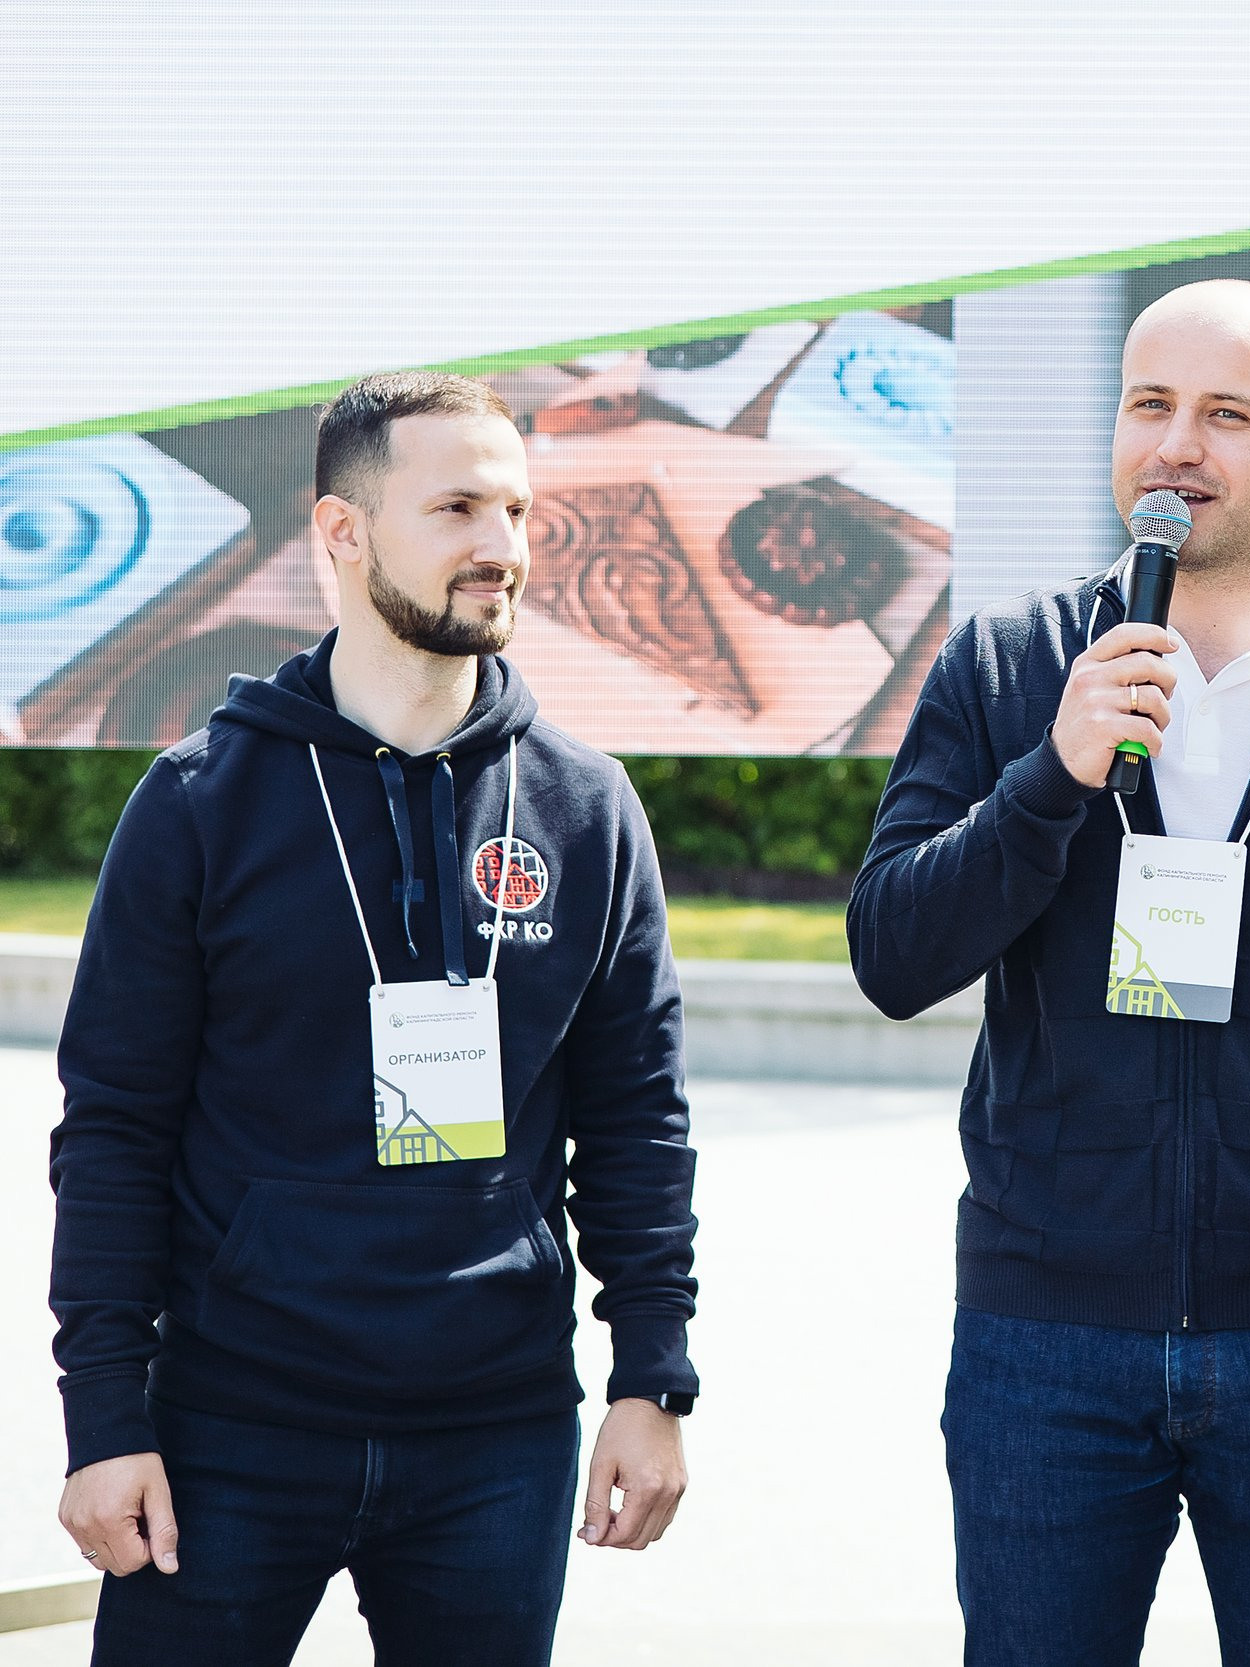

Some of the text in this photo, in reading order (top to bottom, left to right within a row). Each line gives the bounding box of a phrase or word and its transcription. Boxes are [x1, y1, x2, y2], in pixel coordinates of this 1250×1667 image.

[1148, 906, 1206, 925] ГОСТЬ
[524, 921, 554, 941] КО
[388, 1049, 486, 1065] ОРГАНИЗАТОР
